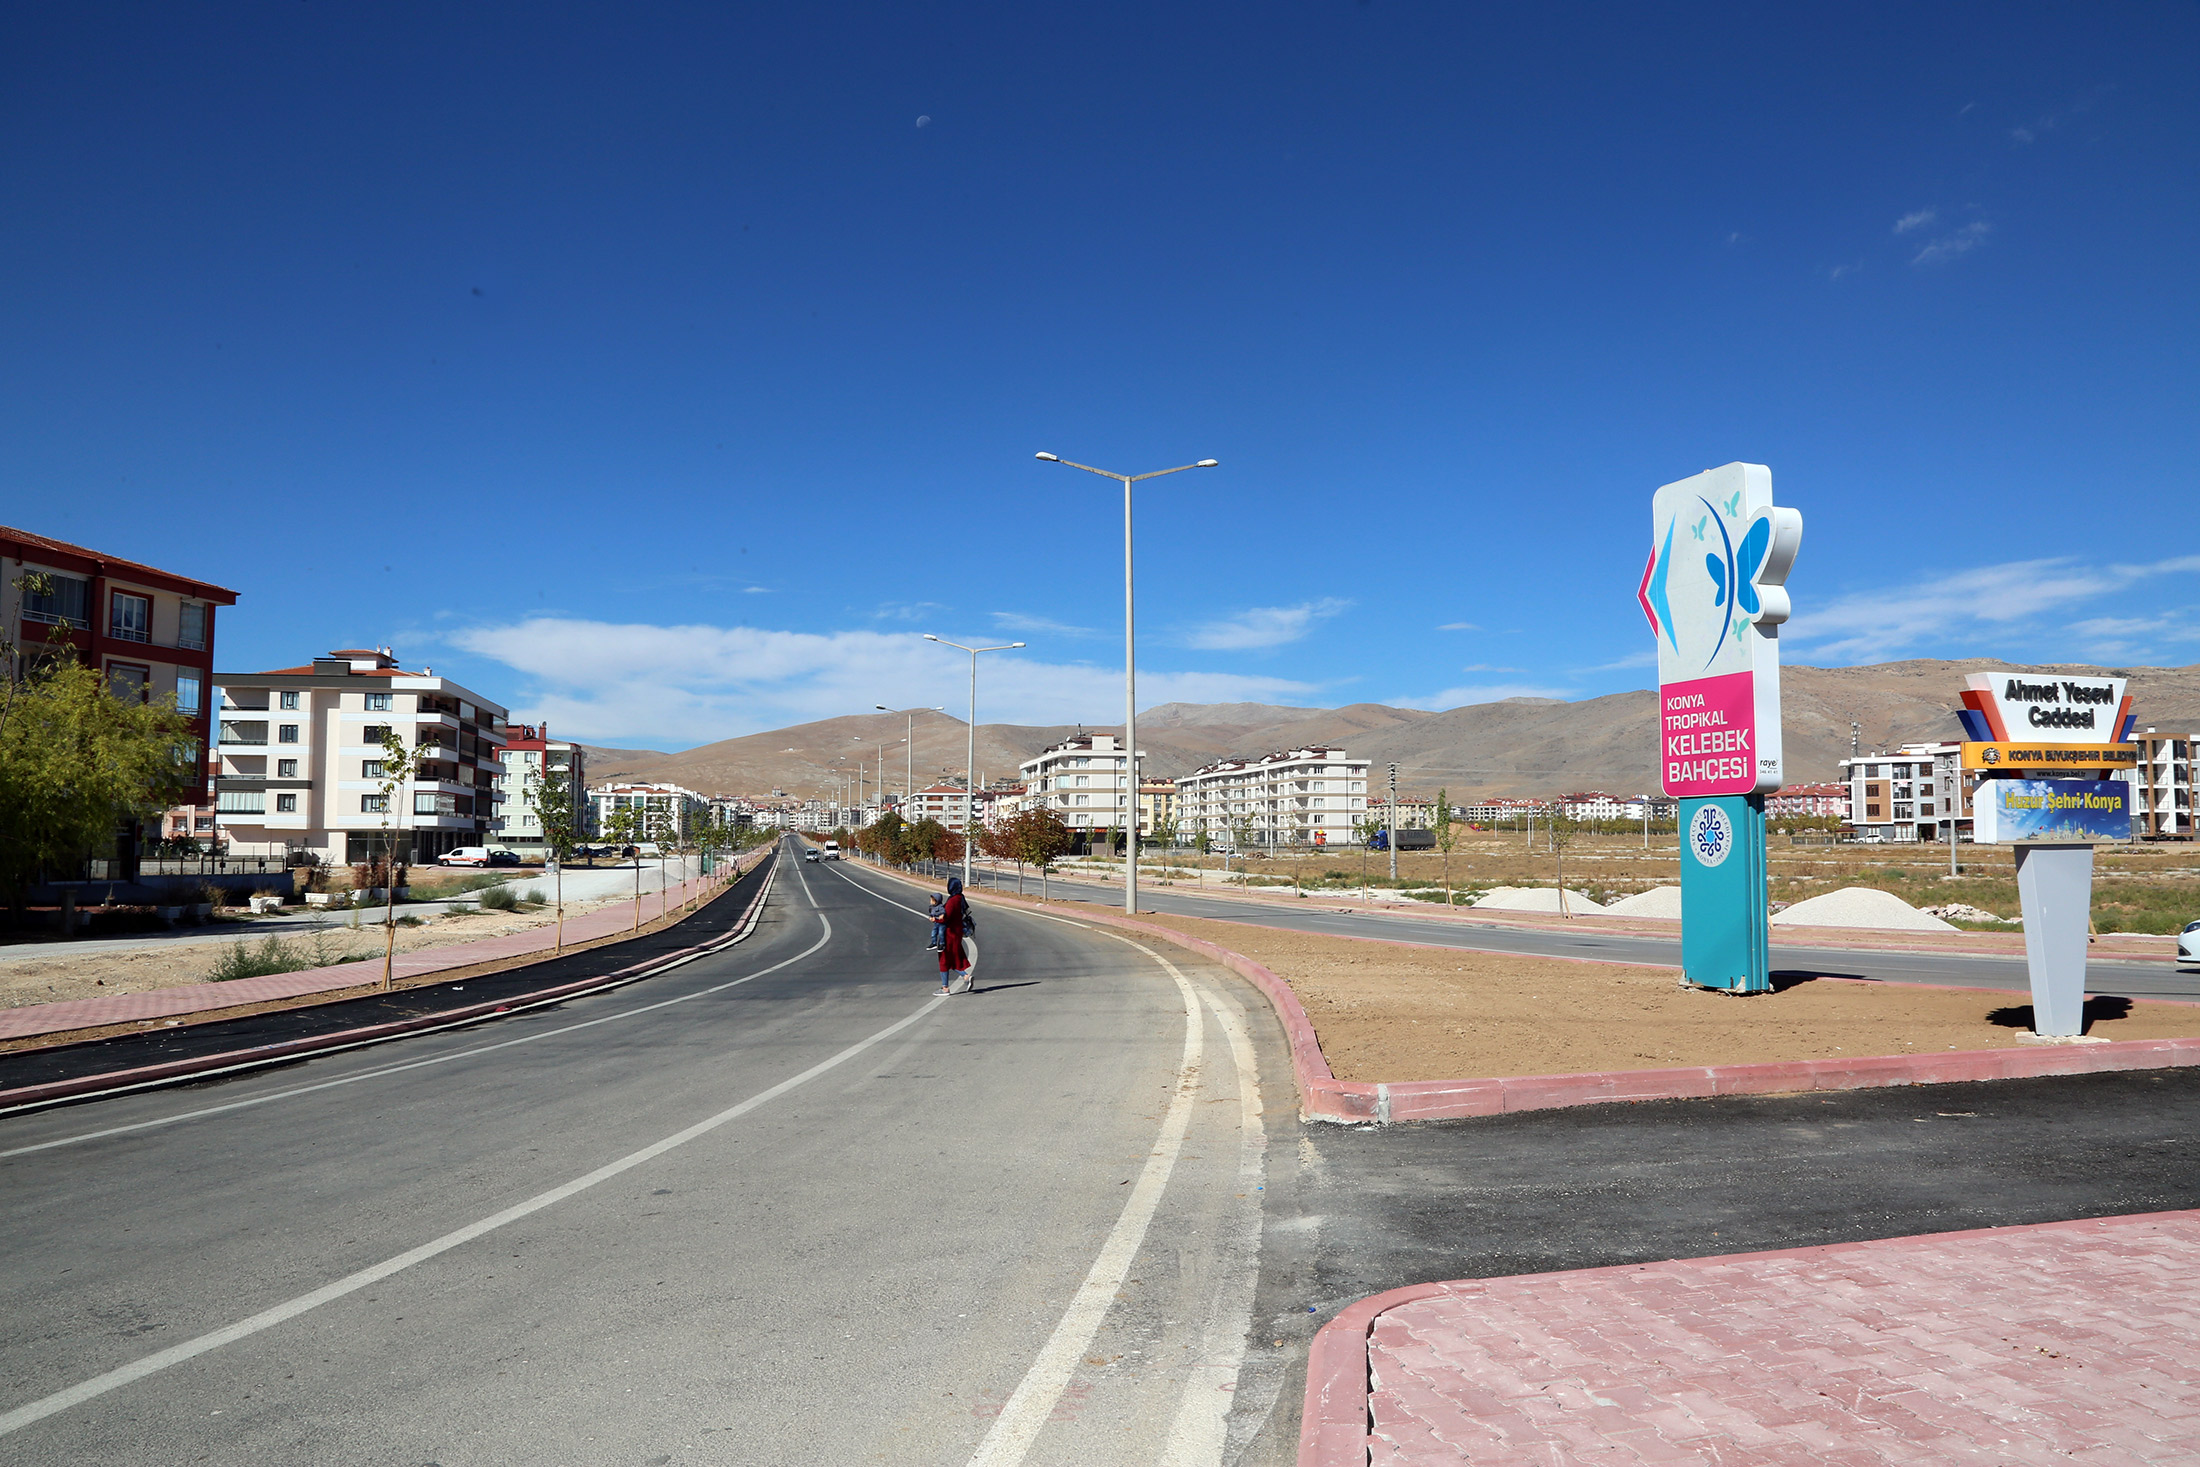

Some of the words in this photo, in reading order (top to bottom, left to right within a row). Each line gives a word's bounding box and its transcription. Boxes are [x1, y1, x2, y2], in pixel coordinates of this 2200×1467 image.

[1667, 693, 1705, 711] KONYA
[2005, 679, 2059, 703] Ahmet
[2062, 682, 2114, 705] Yesevi
[1666, 710, 1728, 731] TROPİKAL
[2028, 705, 2095, 729] Caddesi
[1668, 728, 1750, 757] KELEBEK
[1760, 760, 1777, 768] raye
[2008, 750, 2043, 761] KONYA
[1668, 757, 1748, 783] BAHÇESİ
[2005, 791, 2044, 809] Huzur
[2047, 792, 2081, 813] Şehri
[2084, 793, 2122, 813] Konya
